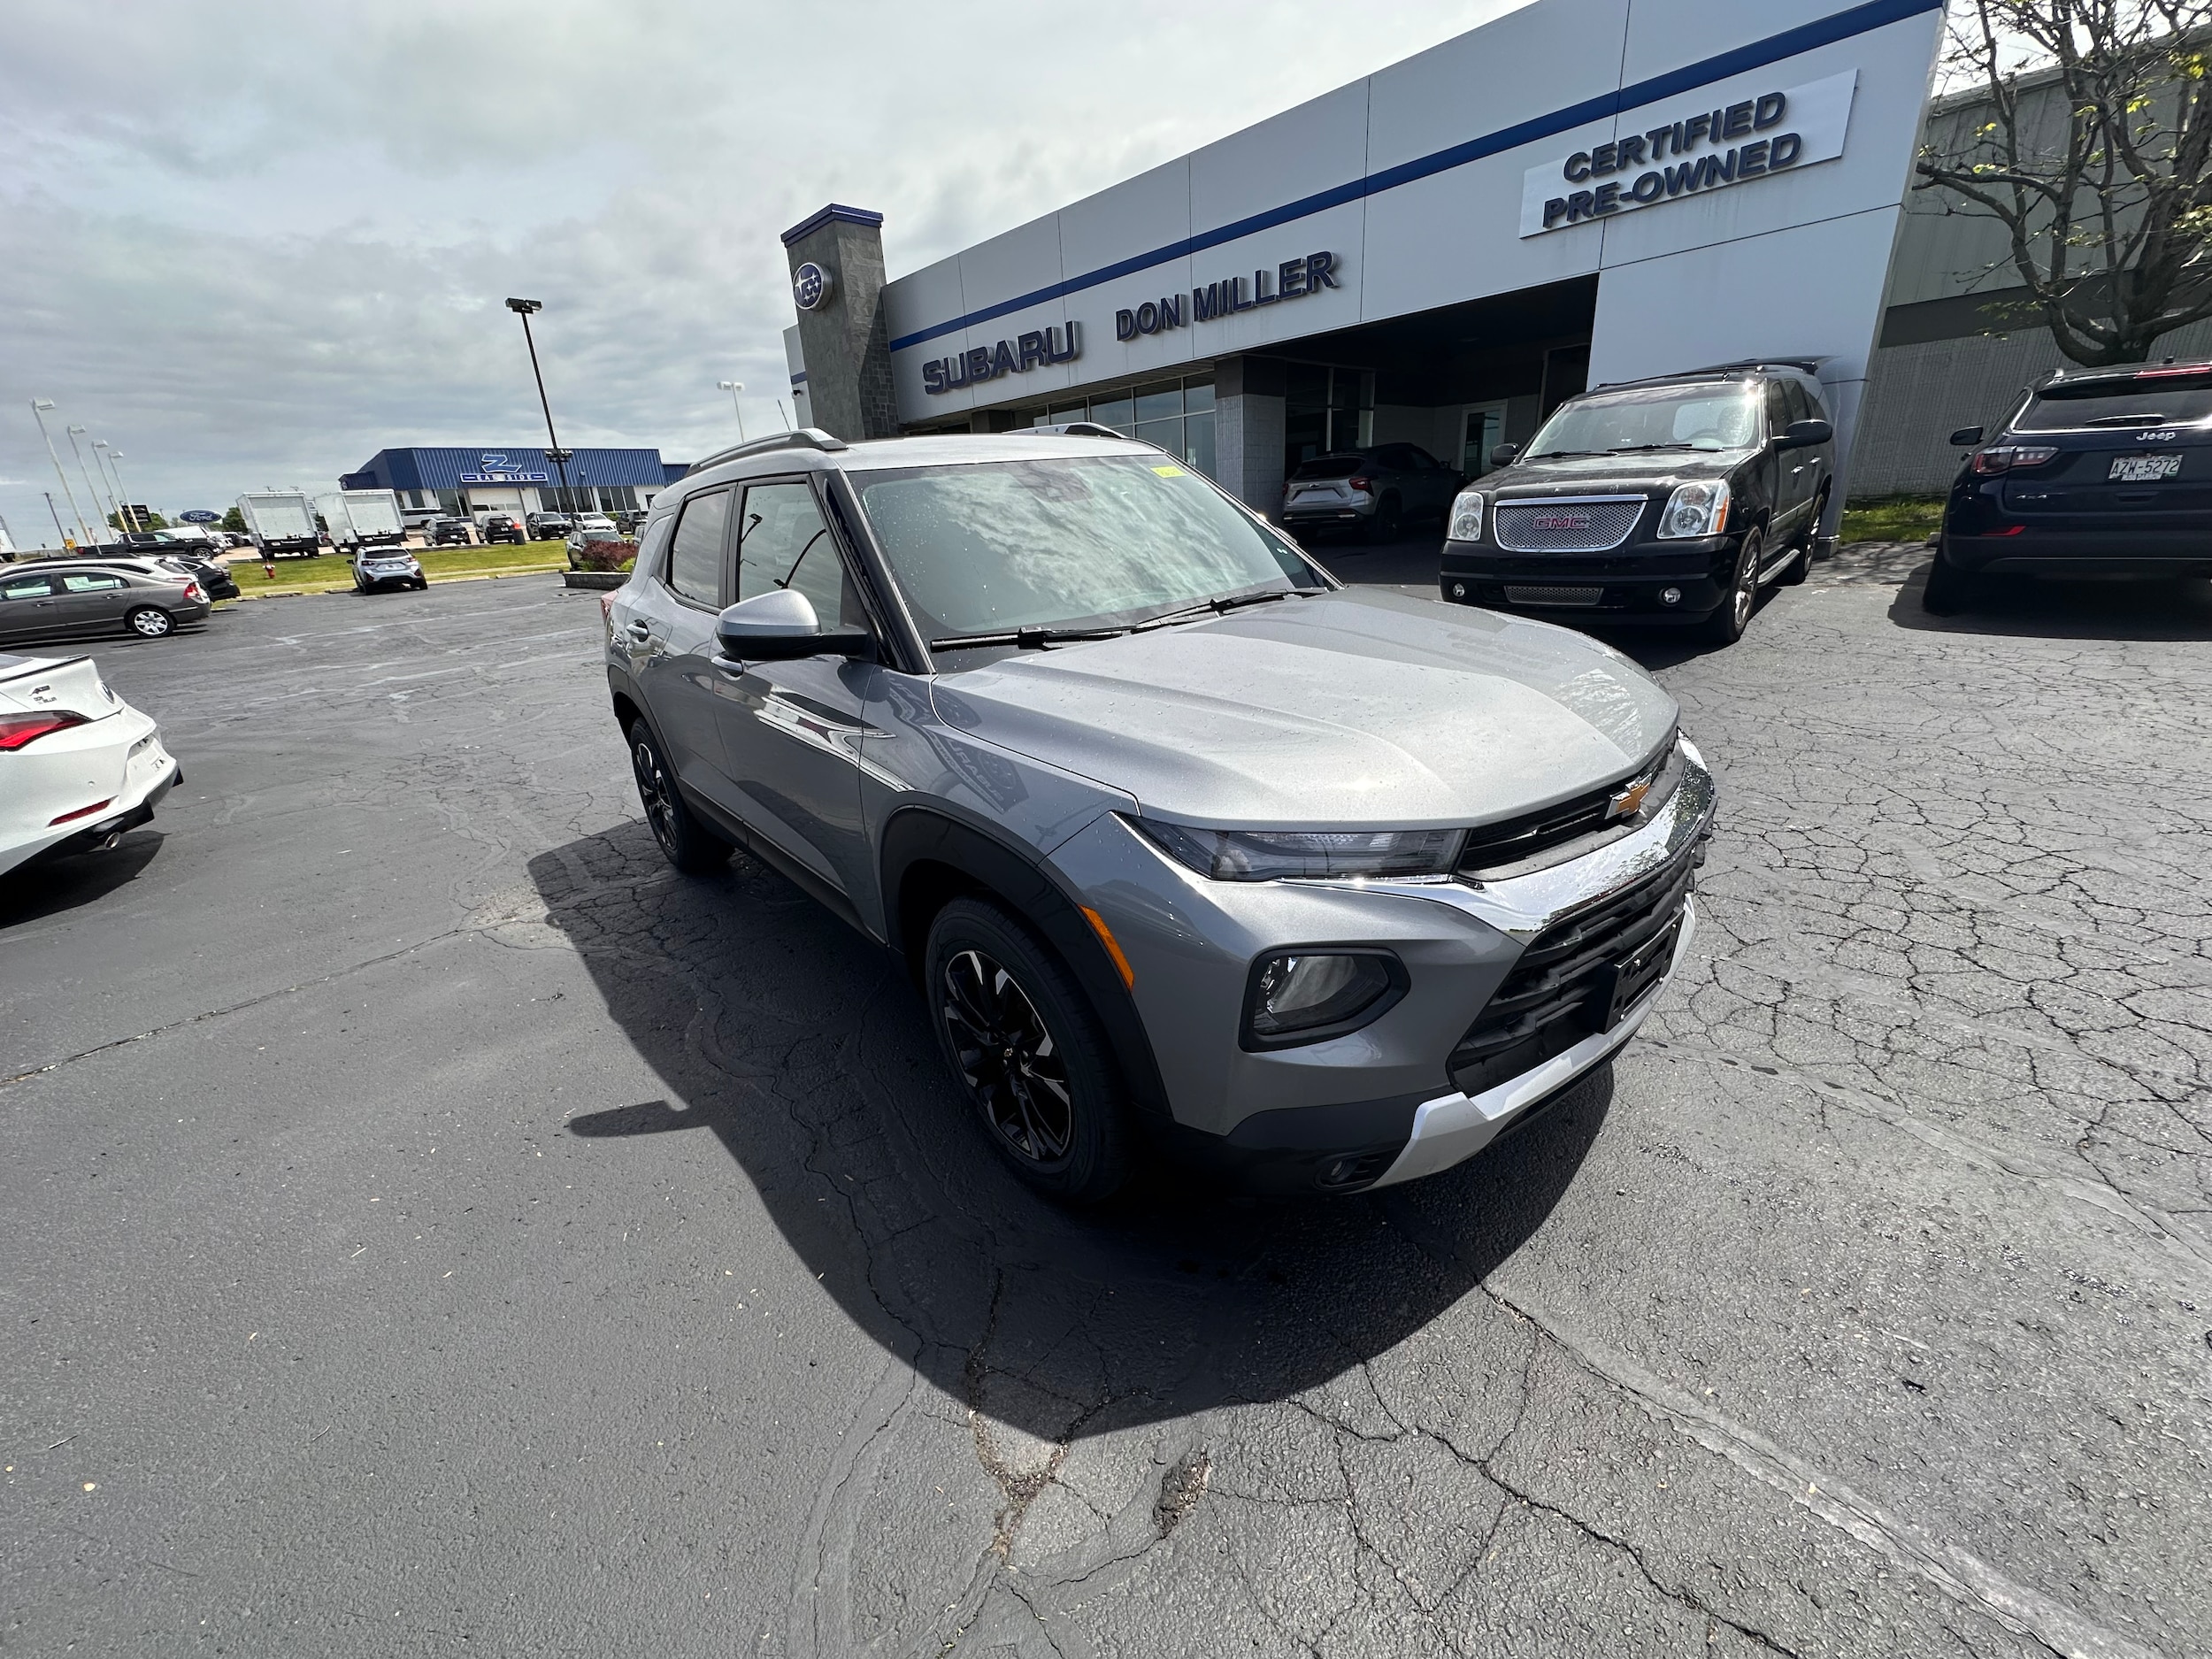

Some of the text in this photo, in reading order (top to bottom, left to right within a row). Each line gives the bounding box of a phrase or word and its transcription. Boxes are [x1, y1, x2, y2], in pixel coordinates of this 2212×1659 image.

[1563, 91, 1786, 182] CERTIFIED
[1542, 133, 1802, 228] PRE-OWNED
[1116, 250, 1340, 342] DON MILLER
[922, 320, 1080, 396] SUBARU
[2136, 432, 2177, 442] Jeep
[2110, 459, 2179, 475] AZW-5272
[188, 512, 213, 521] Ford
[1534, 517, 1590, 529] GMC
